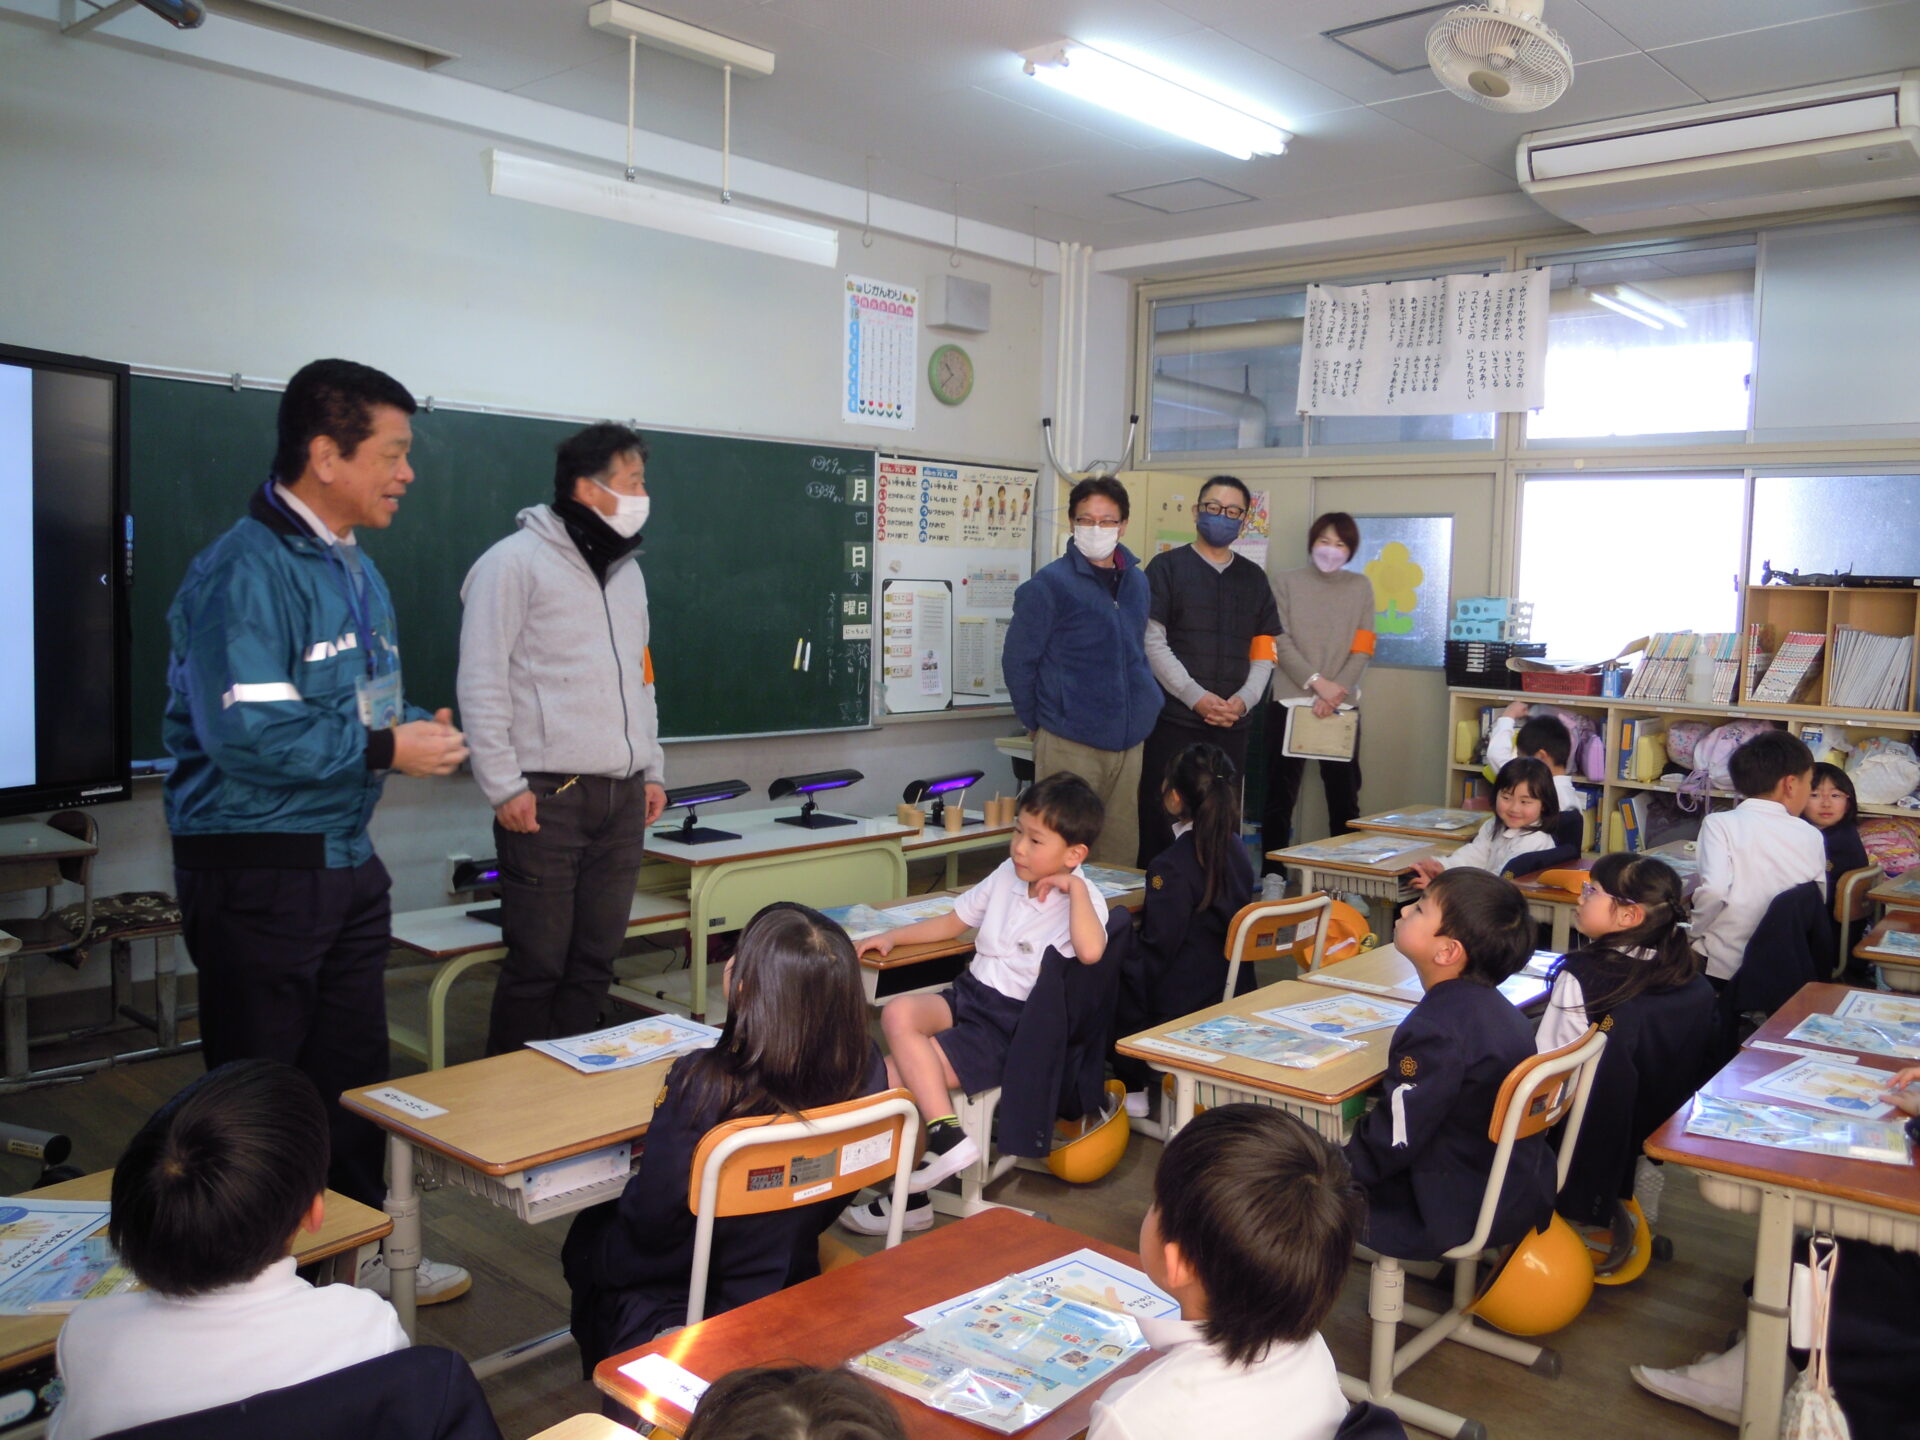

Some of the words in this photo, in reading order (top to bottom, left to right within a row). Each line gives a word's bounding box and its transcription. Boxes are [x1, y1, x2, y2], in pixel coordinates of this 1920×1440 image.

[862, 282, 903, 302] じかんわり
[1456, 291, 1466, 335] いけだしょう
[1467, 290, 1479, 340] つよいよいこの
[1480, 289, 1491, 341] えがおならべて
[1492, 289, 1503, 341] こころのなかに
[1504, 287, 1516, 341] やまのちからが
[1331, 360, 1341, 396] ゆれている
[1341, 362, 1352, 398] ゆれている
[1466, 348, 1475, 400] いつもたのしい
[1478, 351, 1487, 389] むつみあう
[1491, 350, 1499, 388] いきている
[1504, 350, 1512, 388] いきている
[1516, 350, 1525, 389] かつらぎの
[853, 479, 867, 502] 月
[852, 546, 866, 568] 日
[850, 571, 863, 587] 水
[843, 600, 868, 616] 曜日
